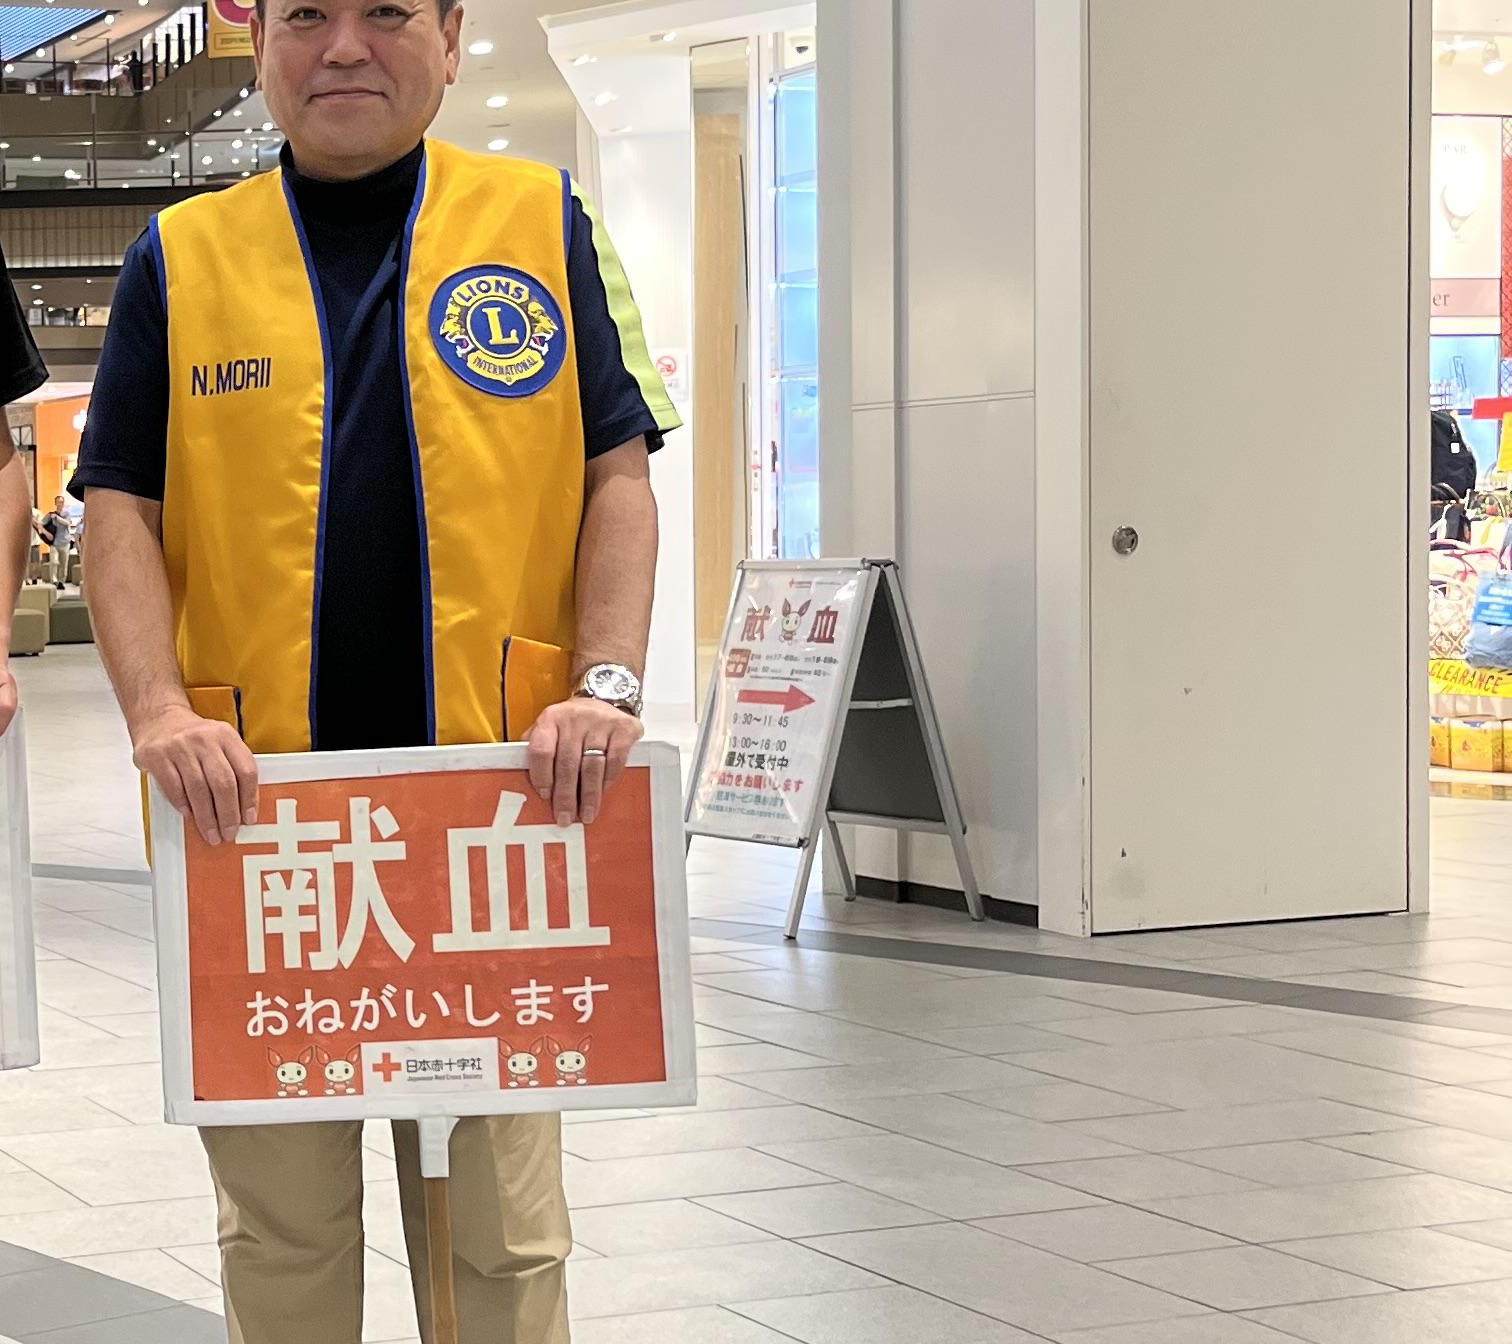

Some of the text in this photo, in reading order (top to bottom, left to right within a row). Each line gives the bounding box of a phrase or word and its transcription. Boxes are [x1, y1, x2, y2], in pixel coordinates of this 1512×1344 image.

[457, 279, 524, 303] LIONS
[482, 307, 519, 345] L
[191, 357, 271, 396] N.MORII
[472, 356, 539, 376] INTERNATIONAL
[1428, 661, 1503, 695] CLEARANCE
[234, 789, 611, 975] 献血
[245, 976, 610, 1038] おねがいします
[406, 1057, 483, 1073] 日本赤十字社
